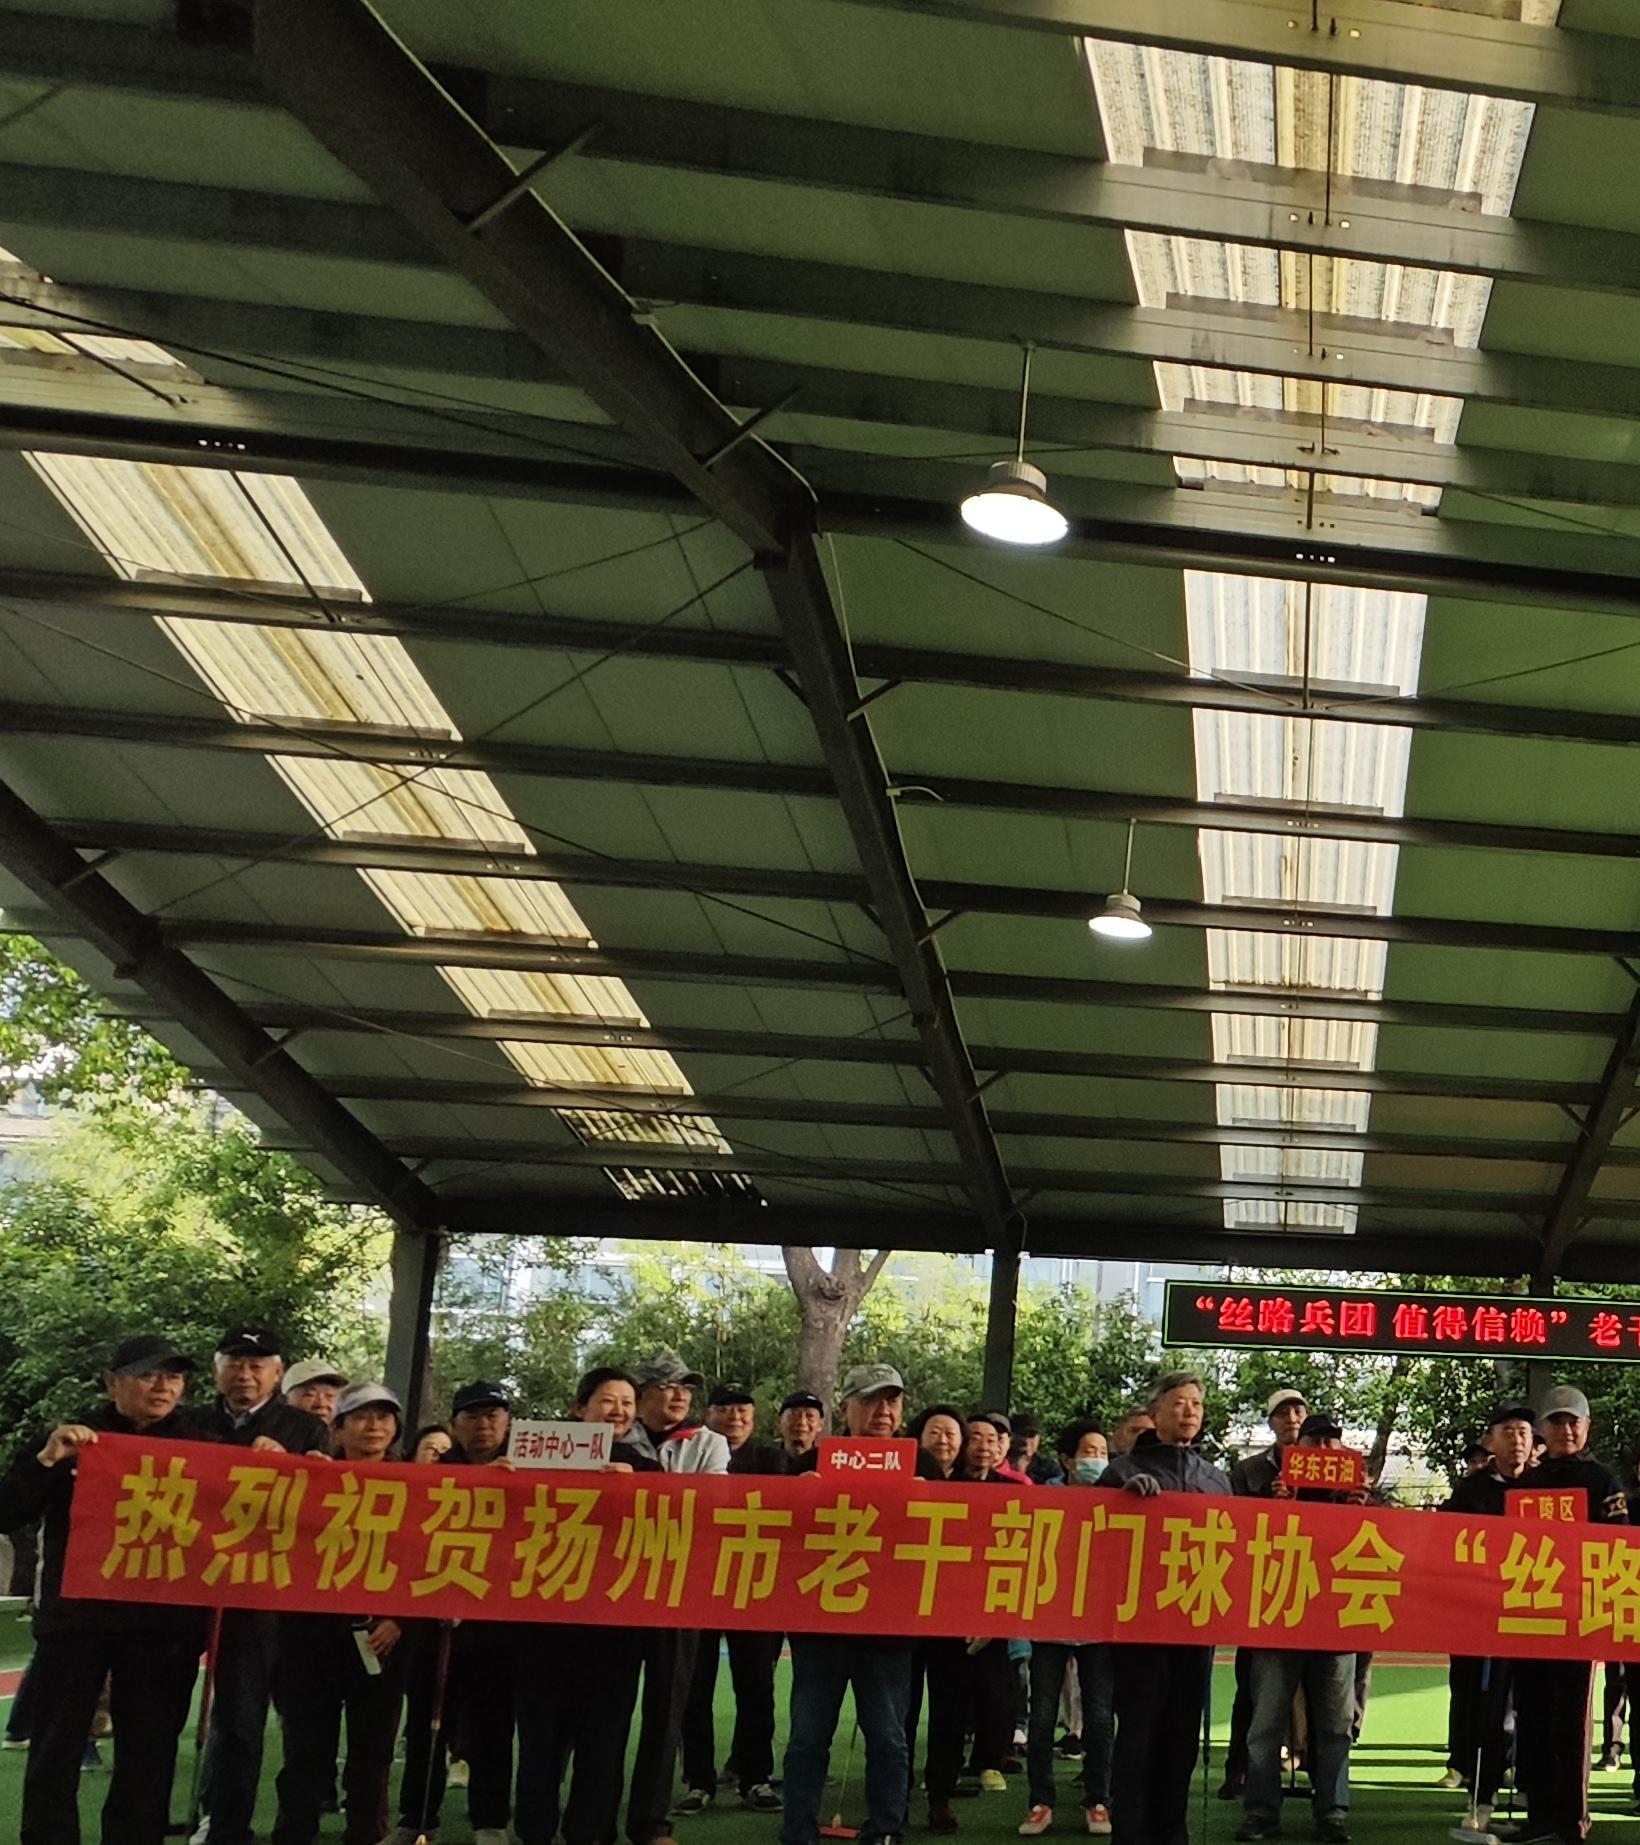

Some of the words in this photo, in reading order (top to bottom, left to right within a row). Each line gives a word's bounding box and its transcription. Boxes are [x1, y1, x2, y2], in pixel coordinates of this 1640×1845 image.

[513, 1430, 604, 1460] 活动中心一队
[830, 1449, 901, 1470] 中心二队
[1288, 1452, 1355, 1483] 华东石油
[1519, 1496, 1575, 1522] 广陵区
